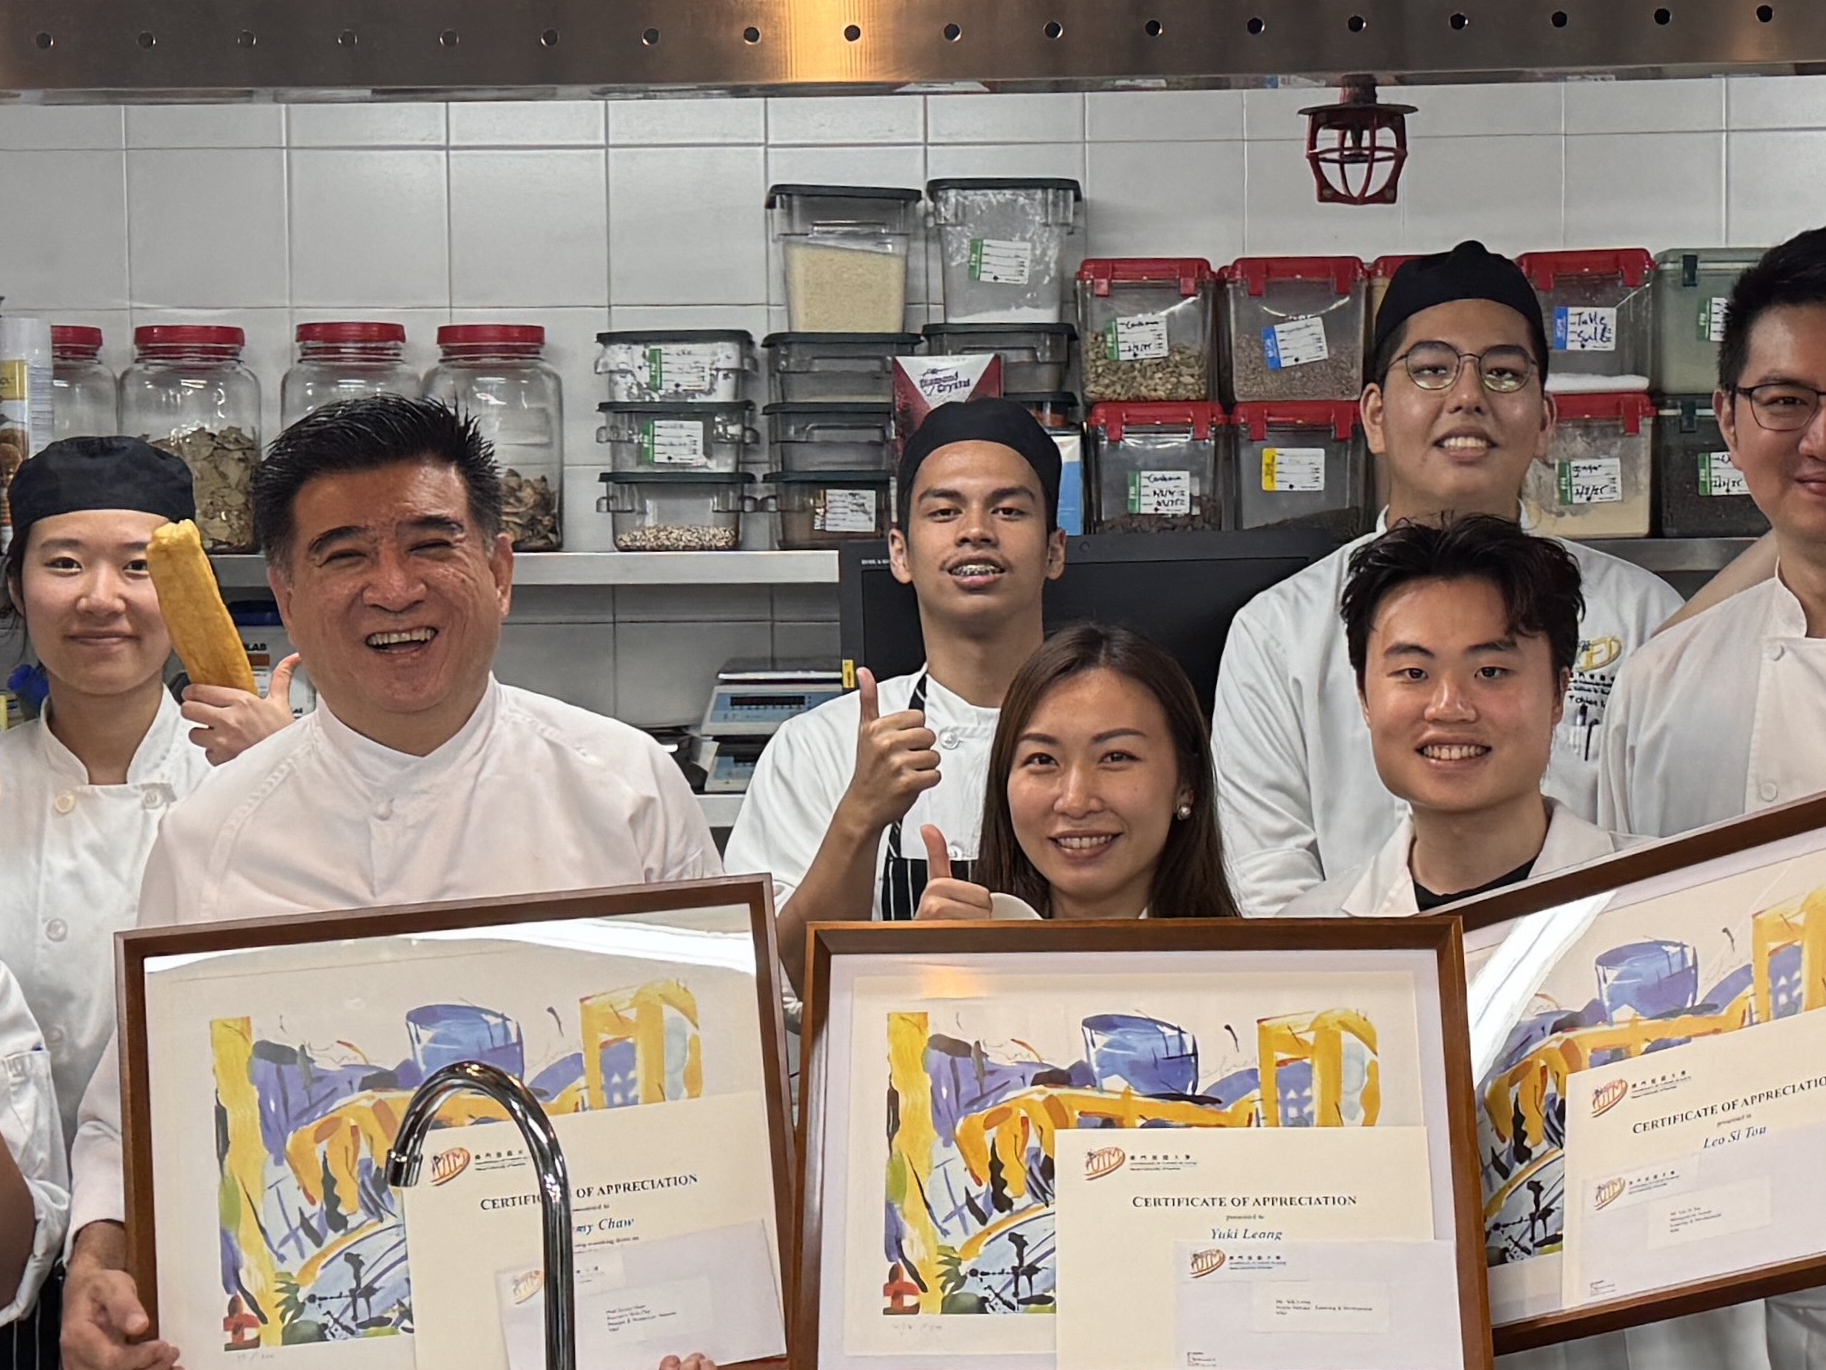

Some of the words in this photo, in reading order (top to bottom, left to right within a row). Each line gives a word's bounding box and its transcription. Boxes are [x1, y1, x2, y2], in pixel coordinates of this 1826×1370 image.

[920, 371, 959, 388] Diamond
[937, 378, 971, 393] Crystal
[1632, 1104, 1718, 1134] CERTIFICATE
[1721, 1099, 1739, 1112] OF
[576, 1186, 594, 1199] OF
[597, 1173, 698, 1196] APPRECIATION
[1133, 1196, 1227, 1208] CERTIFICATE
[1230, 1196, 1250, 1208] OF
[1252, 1195, 1357, 1207] APPRECIATION
[1211, 1228, 1238, 1240] Yuki
